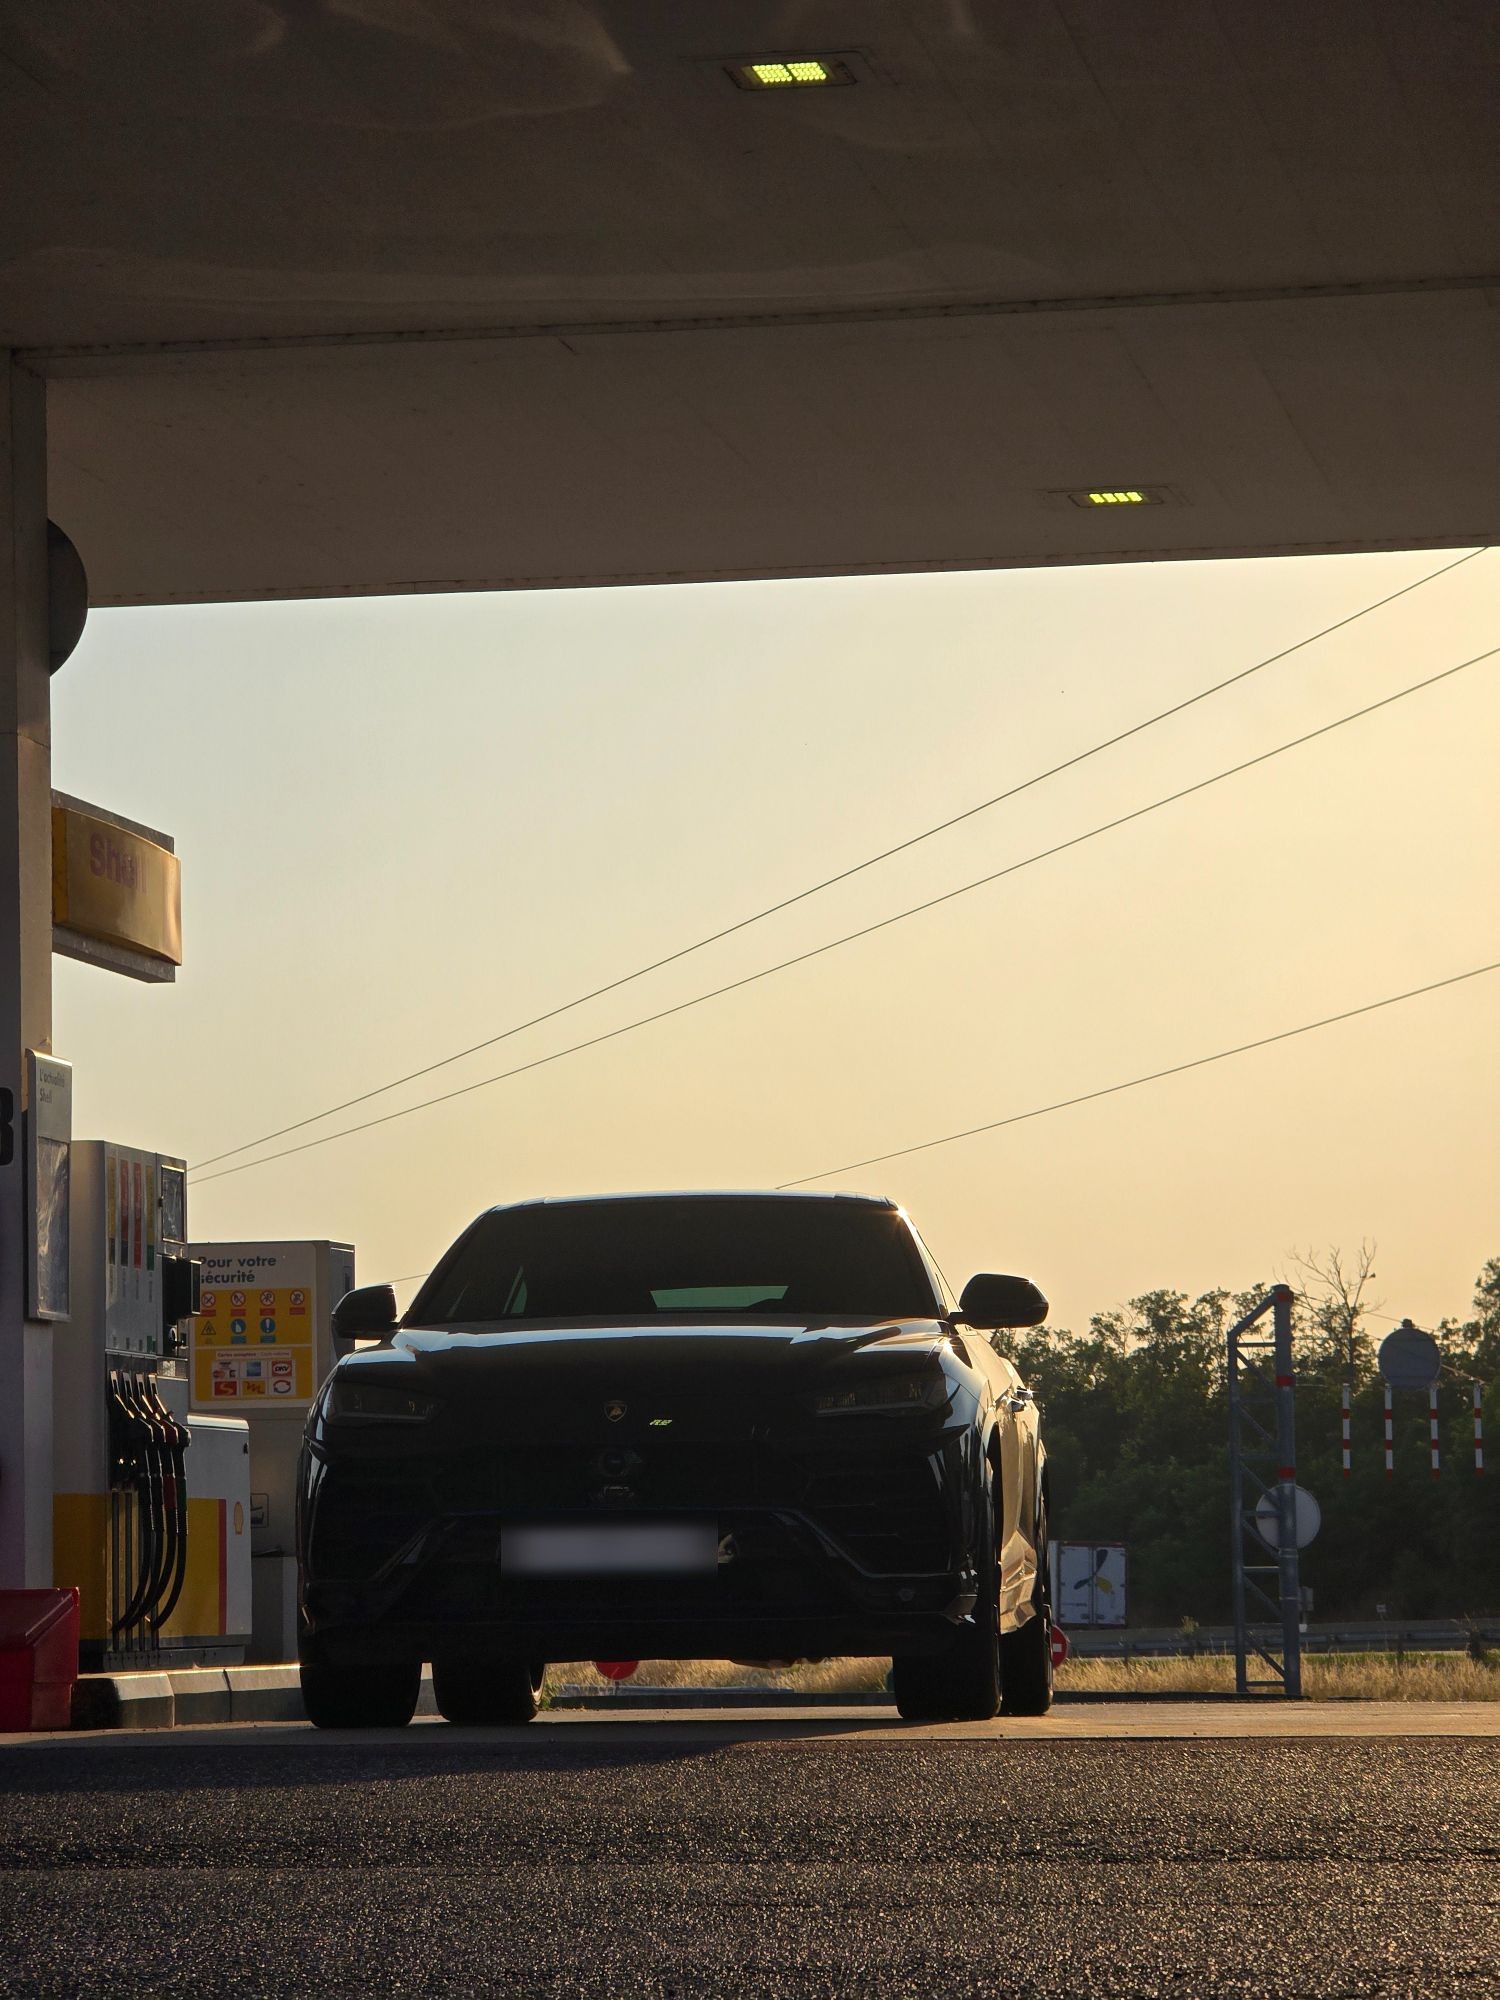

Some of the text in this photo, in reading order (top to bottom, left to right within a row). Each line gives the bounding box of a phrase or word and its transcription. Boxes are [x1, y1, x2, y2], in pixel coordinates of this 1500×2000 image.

[39, 1088, 53, 1104] Shell
[198, 1256, 277, 1268] Pour votre
